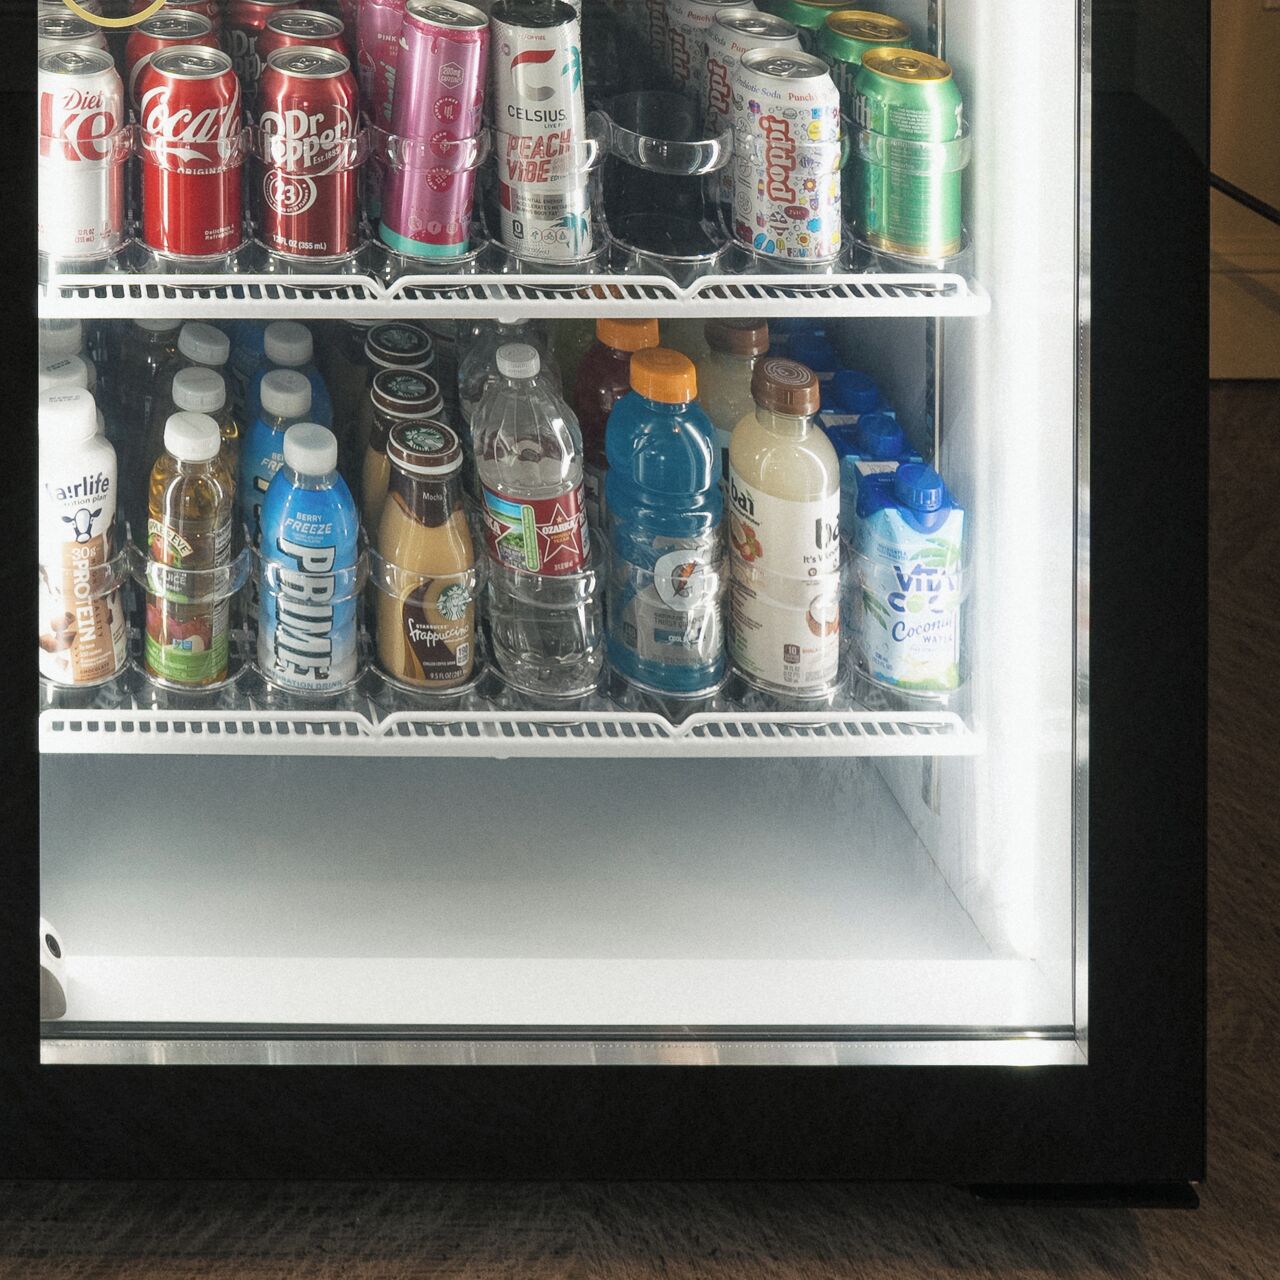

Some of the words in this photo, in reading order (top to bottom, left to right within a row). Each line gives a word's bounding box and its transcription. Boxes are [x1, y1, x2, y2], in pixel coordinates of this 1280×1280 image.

[377, 33, 397, 42] PINK
[63, 88, 105, 110] Diet
[761, 87, 782, 100] Soda
[788, 92, 815, 102] Punch
[284, 109, 324, 137] Dr
[508, 105, 567, 123] CELSIUS
[260, 111, 347, 171] Pepper
[506, 128, 573, 159] PEACH
[759, 115, 797, 203] poppi
[506, 159, 551, 183] VIBE
[275, 180, 296, 205] 23
[289, 240, 297, 248] OZ
[298, 237, 313, 250] (355
[314, 241, 327, 251] mL)
[423, 492, 443, 501] Mocha
[731, 477, 755, 516] bai
[284, 518, 333, 535] FREEZE
[297, 512, 322, 522] BERRY
[72, 547, 97, 561] 30g
[171, 534, 191, 554] EVE
[803, 555, 817, 564] It's
[73, 559, 97, 643] PROTEIN
[276, 537, 336, 680] PRIME
[408, 618, 470, 647] frappuccino
